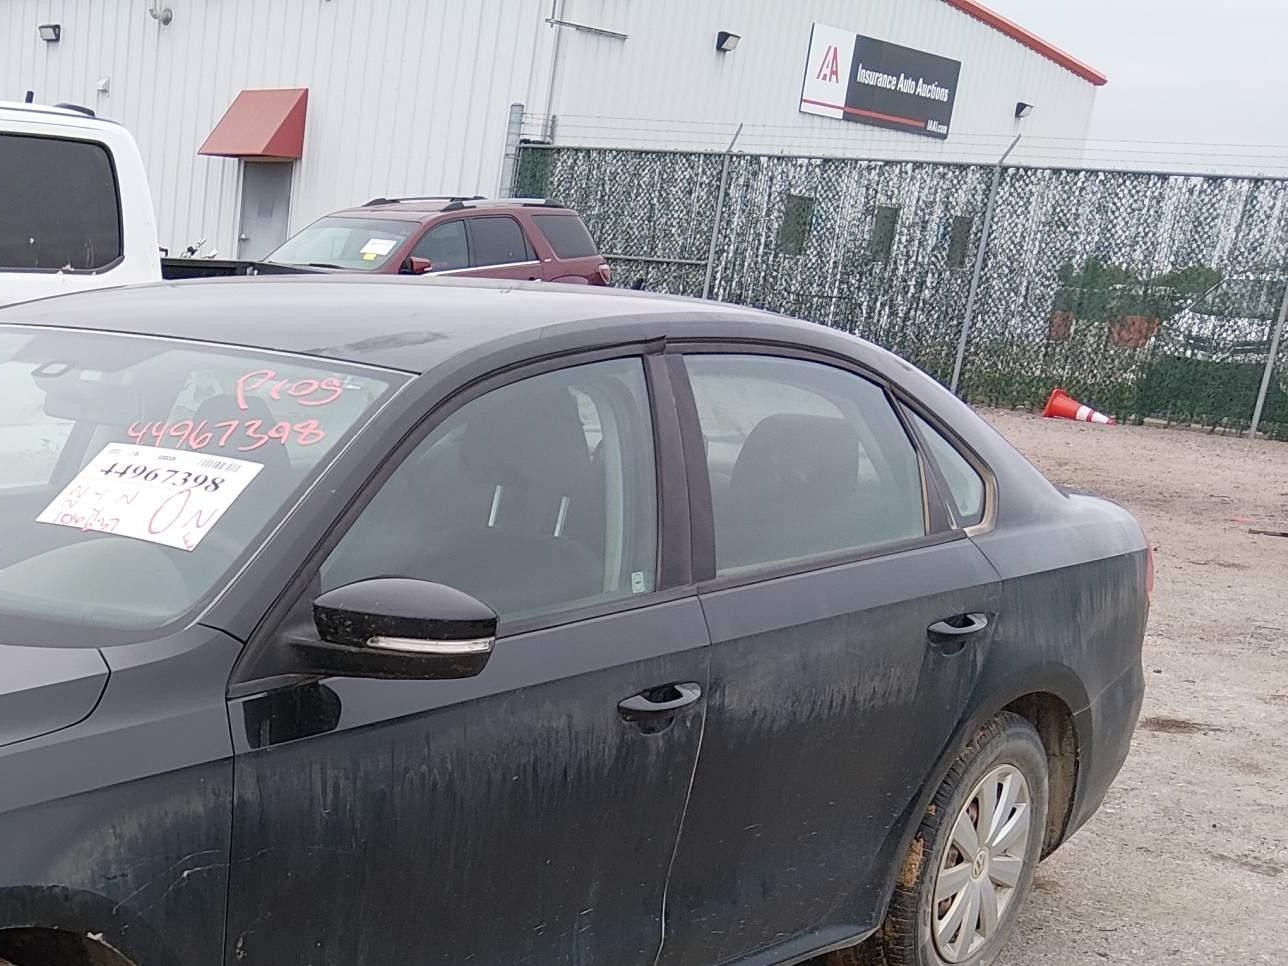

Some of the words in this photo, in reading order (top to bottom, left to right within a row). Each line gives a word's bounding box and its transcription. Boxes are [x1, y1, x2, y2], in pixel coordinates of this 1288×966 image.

[856, 63, 897, 91] Insurance
[896, 73, 917, 96] Auto
[915, 78, 950, 102] Auctions
[127, 419, 326, 452] 44967398
[100, 462, 226, 493] 44967398
